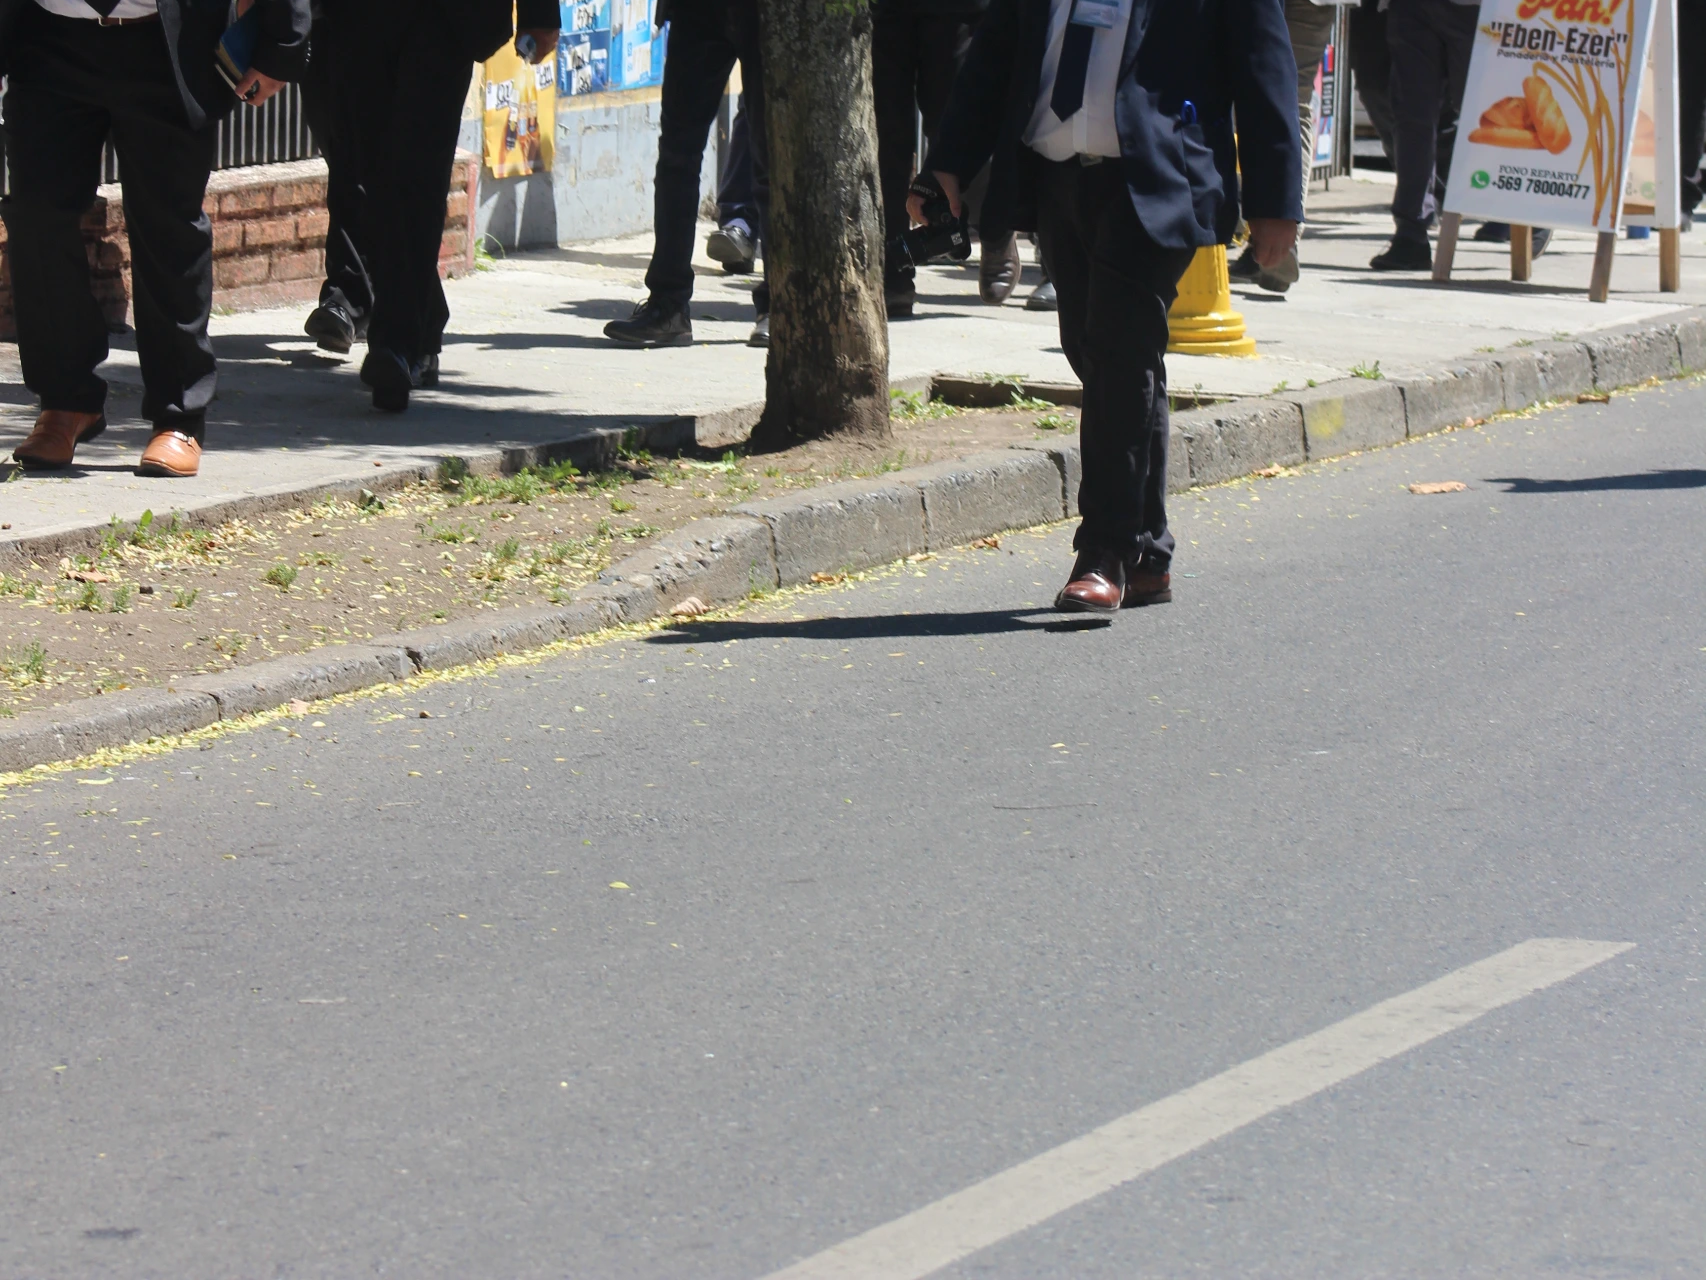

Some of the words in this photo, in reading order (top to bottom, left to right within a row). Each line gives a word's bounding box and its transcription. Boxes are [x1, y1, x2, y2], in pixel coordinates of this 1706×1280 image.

[1499, 164, 1528, 176] FONO
[1530, 168, 1580, 182] REPARTO
[1526, 178, 1590, 200] 78000477
